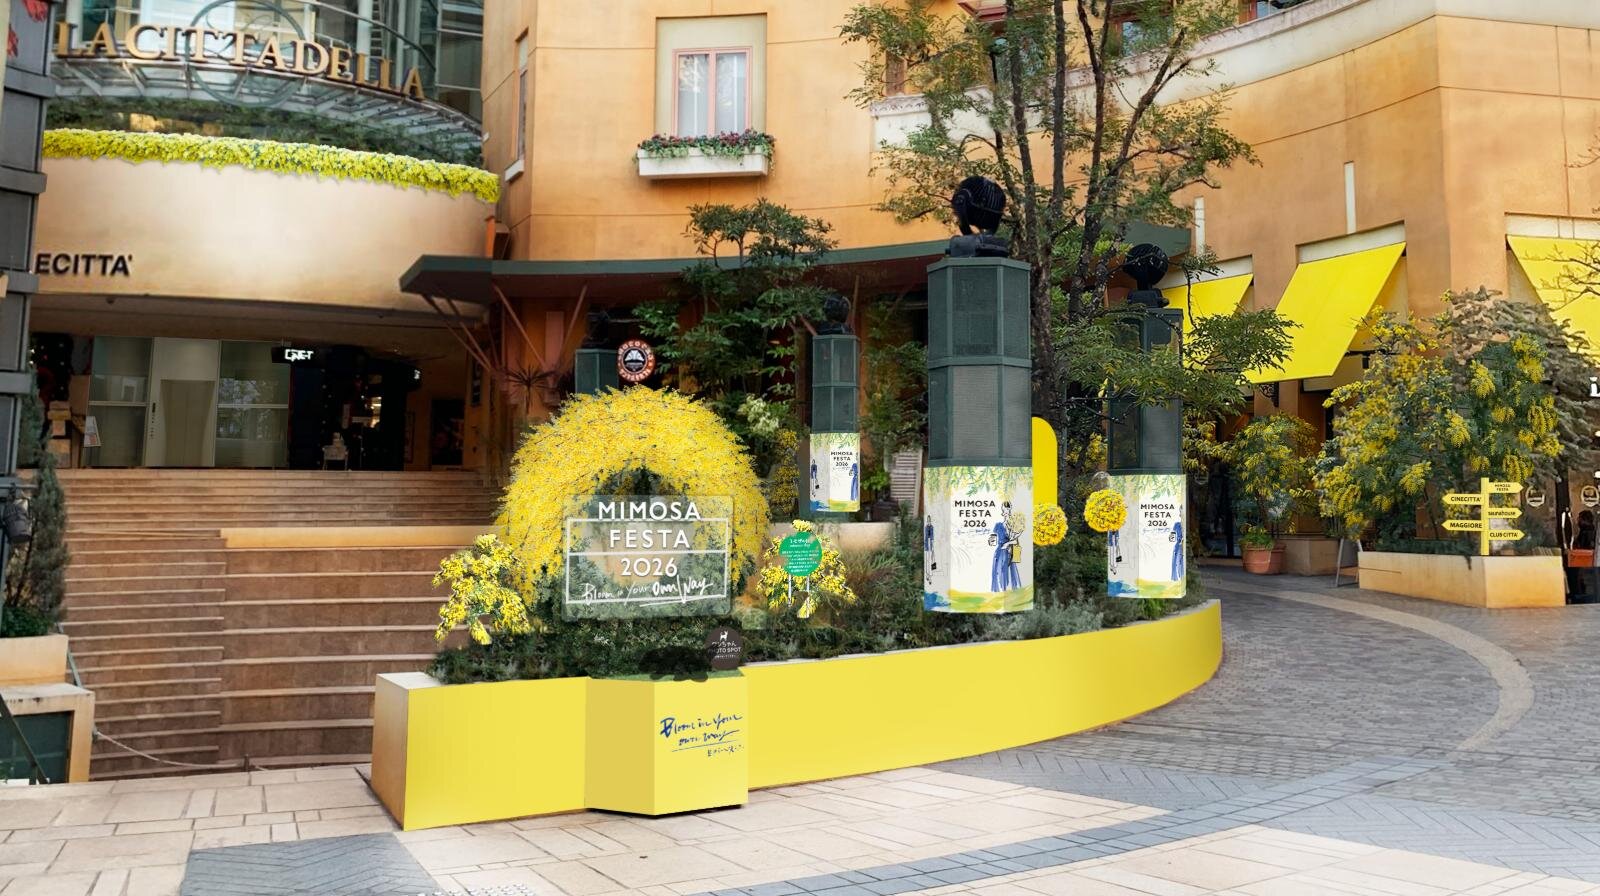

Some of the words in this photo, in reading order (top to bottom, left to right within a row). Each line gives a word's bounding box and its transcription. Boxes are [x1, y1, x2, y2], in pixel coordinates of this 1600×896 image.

[34, 252, 133, 277] ECITTA'
[597, 501, 701, 520] MIMOSA
[954, 500, 996, 508] MIMOSA
[959, 509, 992, 517] FESTA
[609, 529, 690, 548] FESTA
[620, 557, 678, 577] 2026
